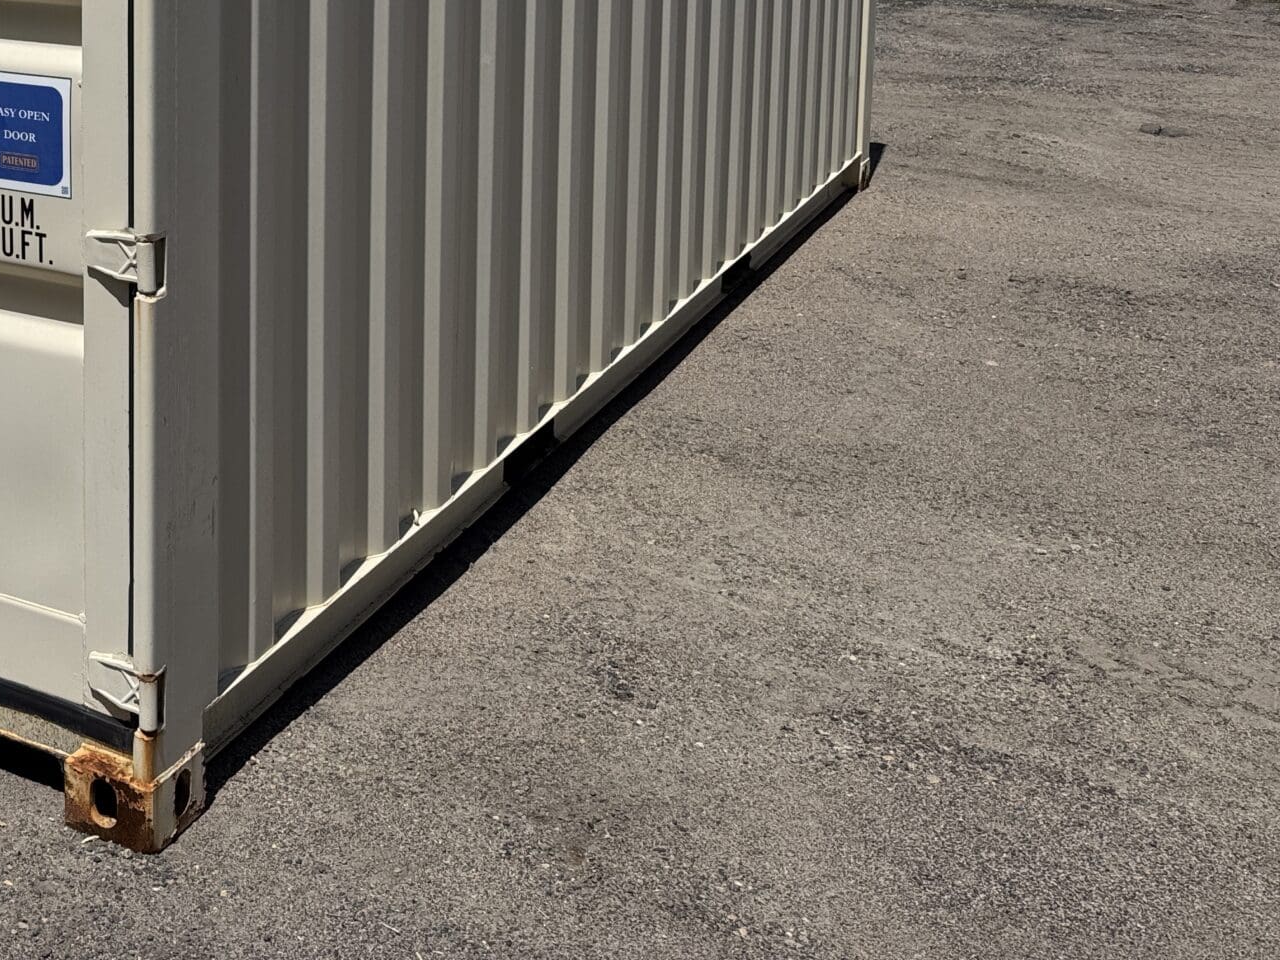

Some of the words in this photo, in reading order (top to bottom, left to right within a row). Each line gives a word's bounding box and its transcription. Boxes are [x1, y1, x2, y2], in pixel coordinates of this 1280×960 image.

[18, 109, 50, 122] OPEN
[3, 129, 37, 143] DOOR
[2, 155, 37, 168] PATENTED
